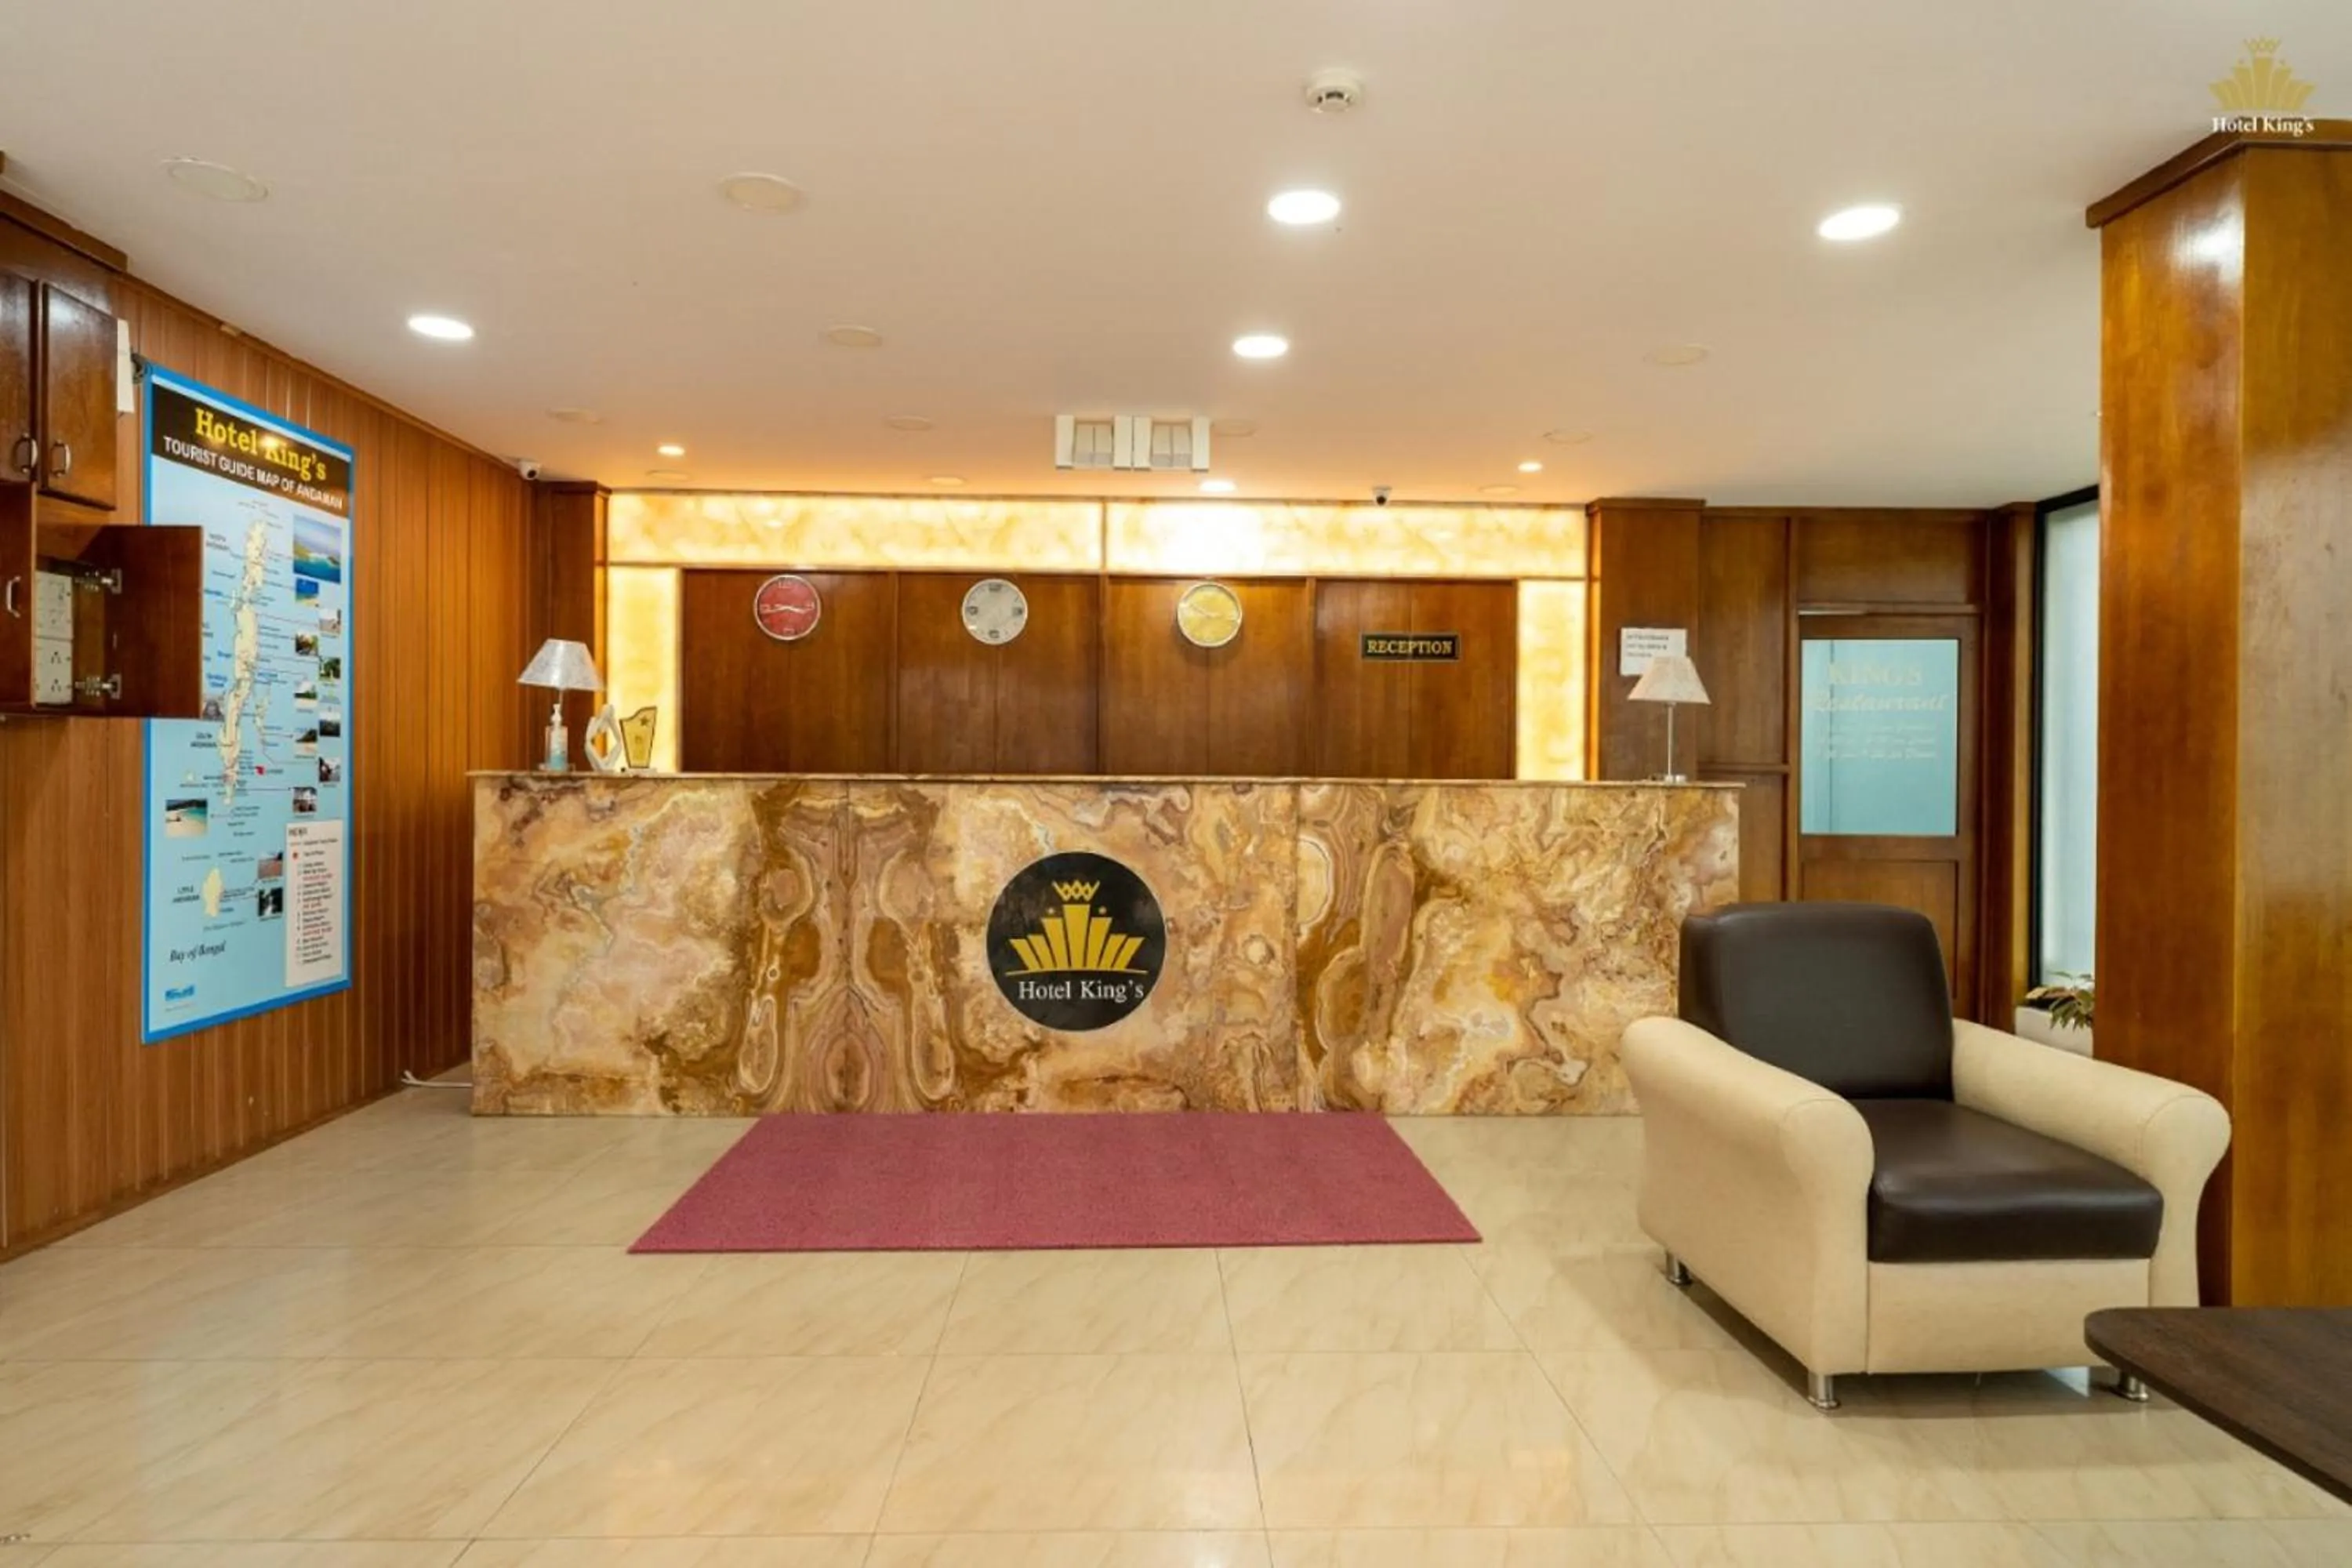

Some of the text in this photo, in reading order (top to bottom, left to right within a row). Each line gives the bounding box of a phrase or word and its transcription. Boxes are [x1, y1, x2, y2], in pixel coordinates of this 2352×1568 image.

[195, 407, 326, 481] Hotel King's
[163, 435, 343, 510] TOURIST GUIDE MAP OF ANDAMAN
[1367, 640, 1453, 654] RECEPTION
[1018, 980, 1145, 1004] Hotel King's
